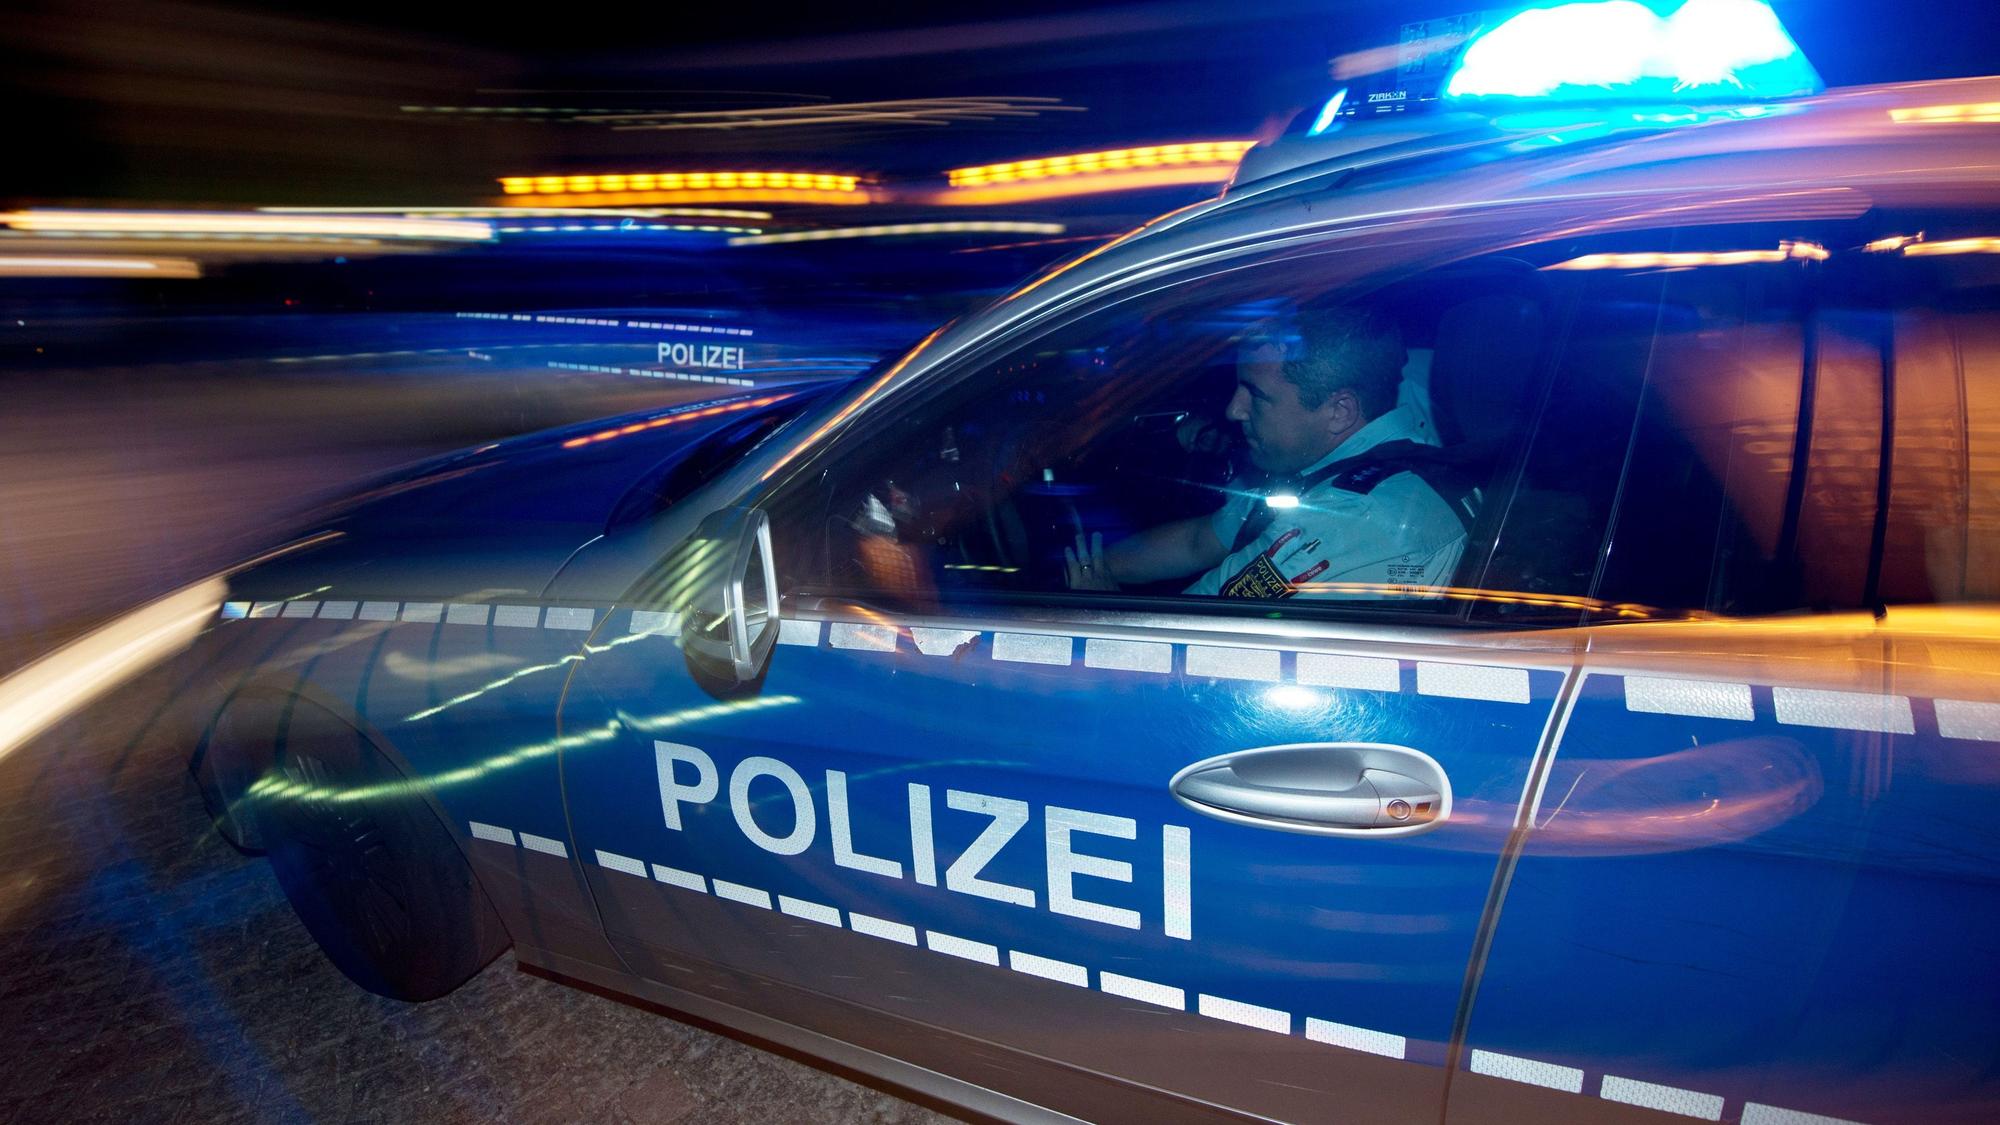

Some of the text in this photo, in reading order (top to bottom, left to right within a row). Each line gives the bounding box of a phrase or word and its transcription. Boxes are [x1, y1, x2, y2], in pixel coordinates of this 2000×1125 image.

[658, 342, 744, 370] POLIZEI
[1256, 560, 1283, 594] POLIZEI
[653, 739, 1192, 941] POLIZEI
